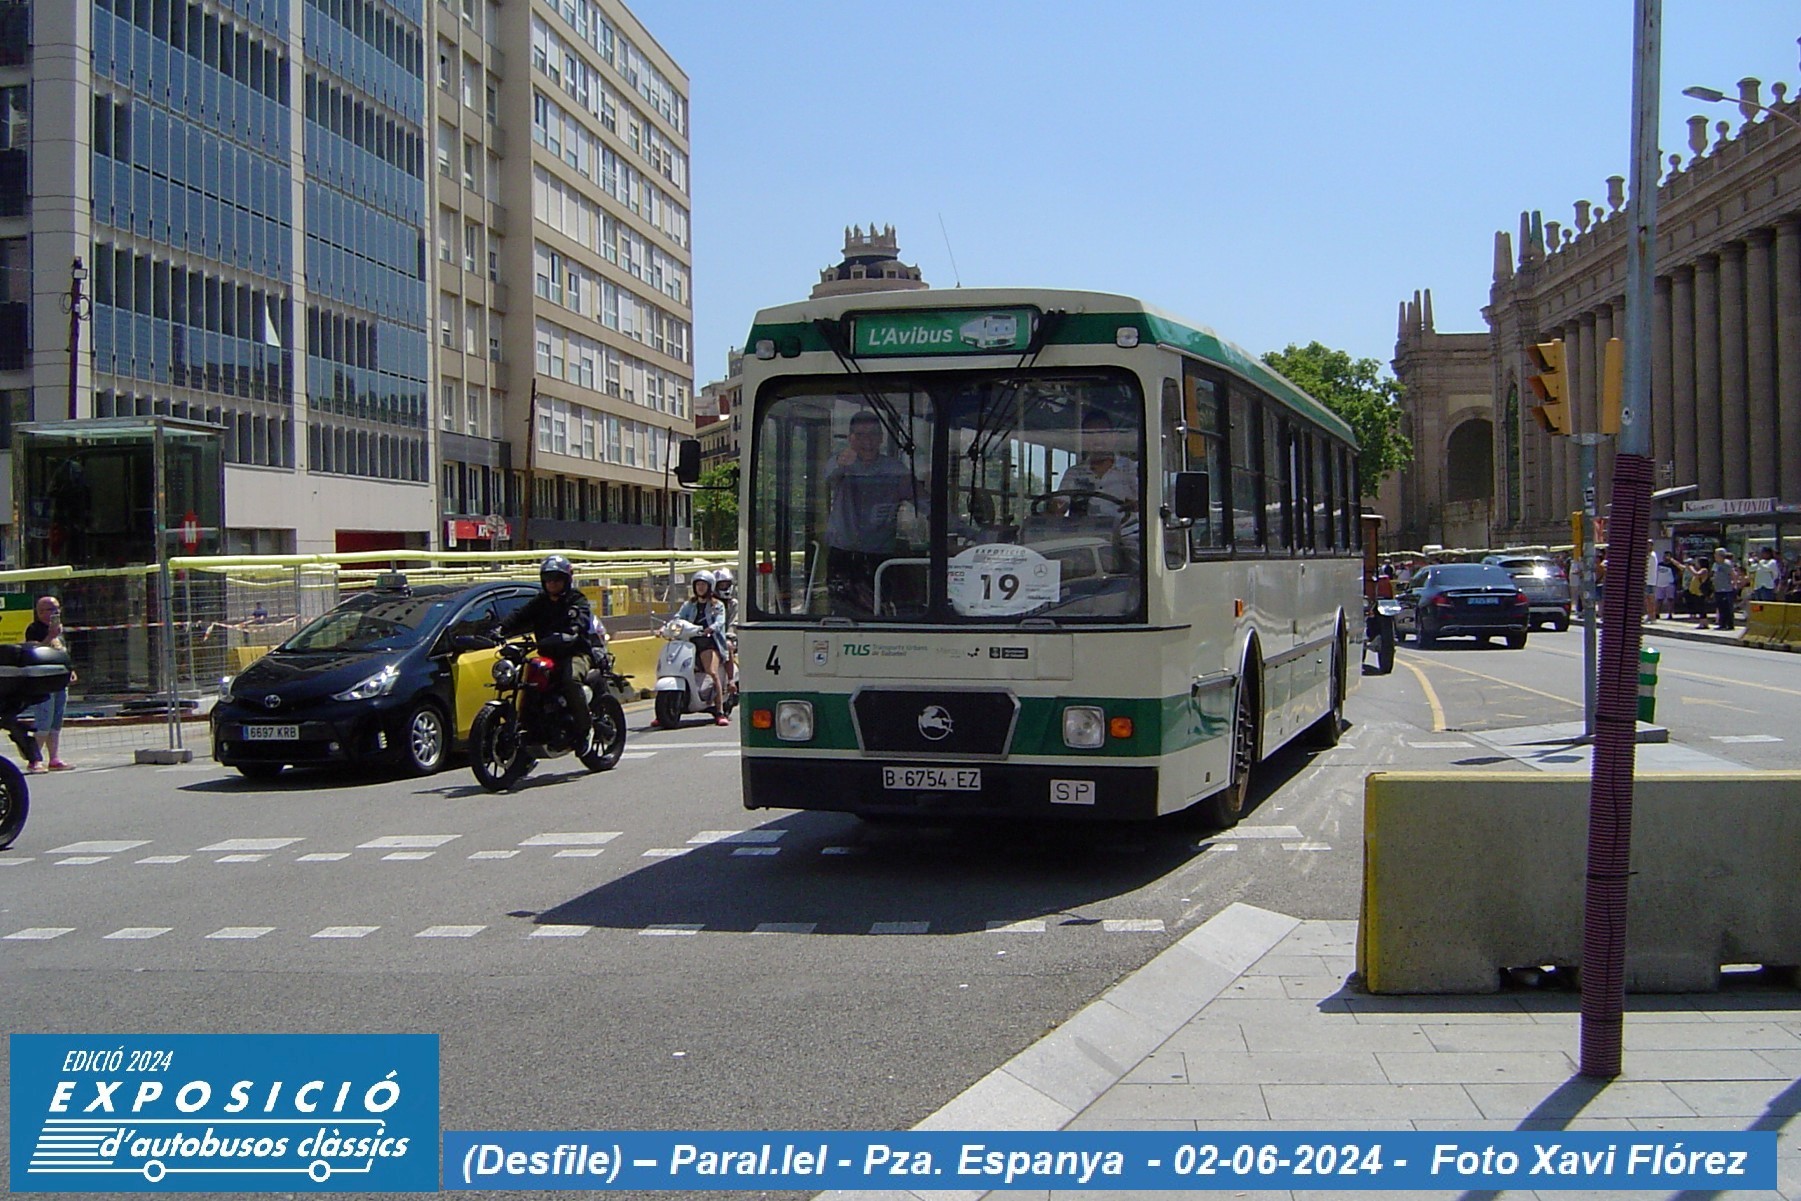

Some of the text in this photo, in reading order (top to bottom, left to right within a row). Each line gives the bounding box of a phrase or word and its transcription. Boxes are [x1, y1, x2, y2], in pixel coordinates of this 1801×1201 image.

[868, 326, 953, 346] L'Avibus
[981, 573, 1020, 600] 19
[765, 645, 781, 675] 4
[843, 644, 870, 656] TUS
[250, 726, 297, 738] 6697 KRB
